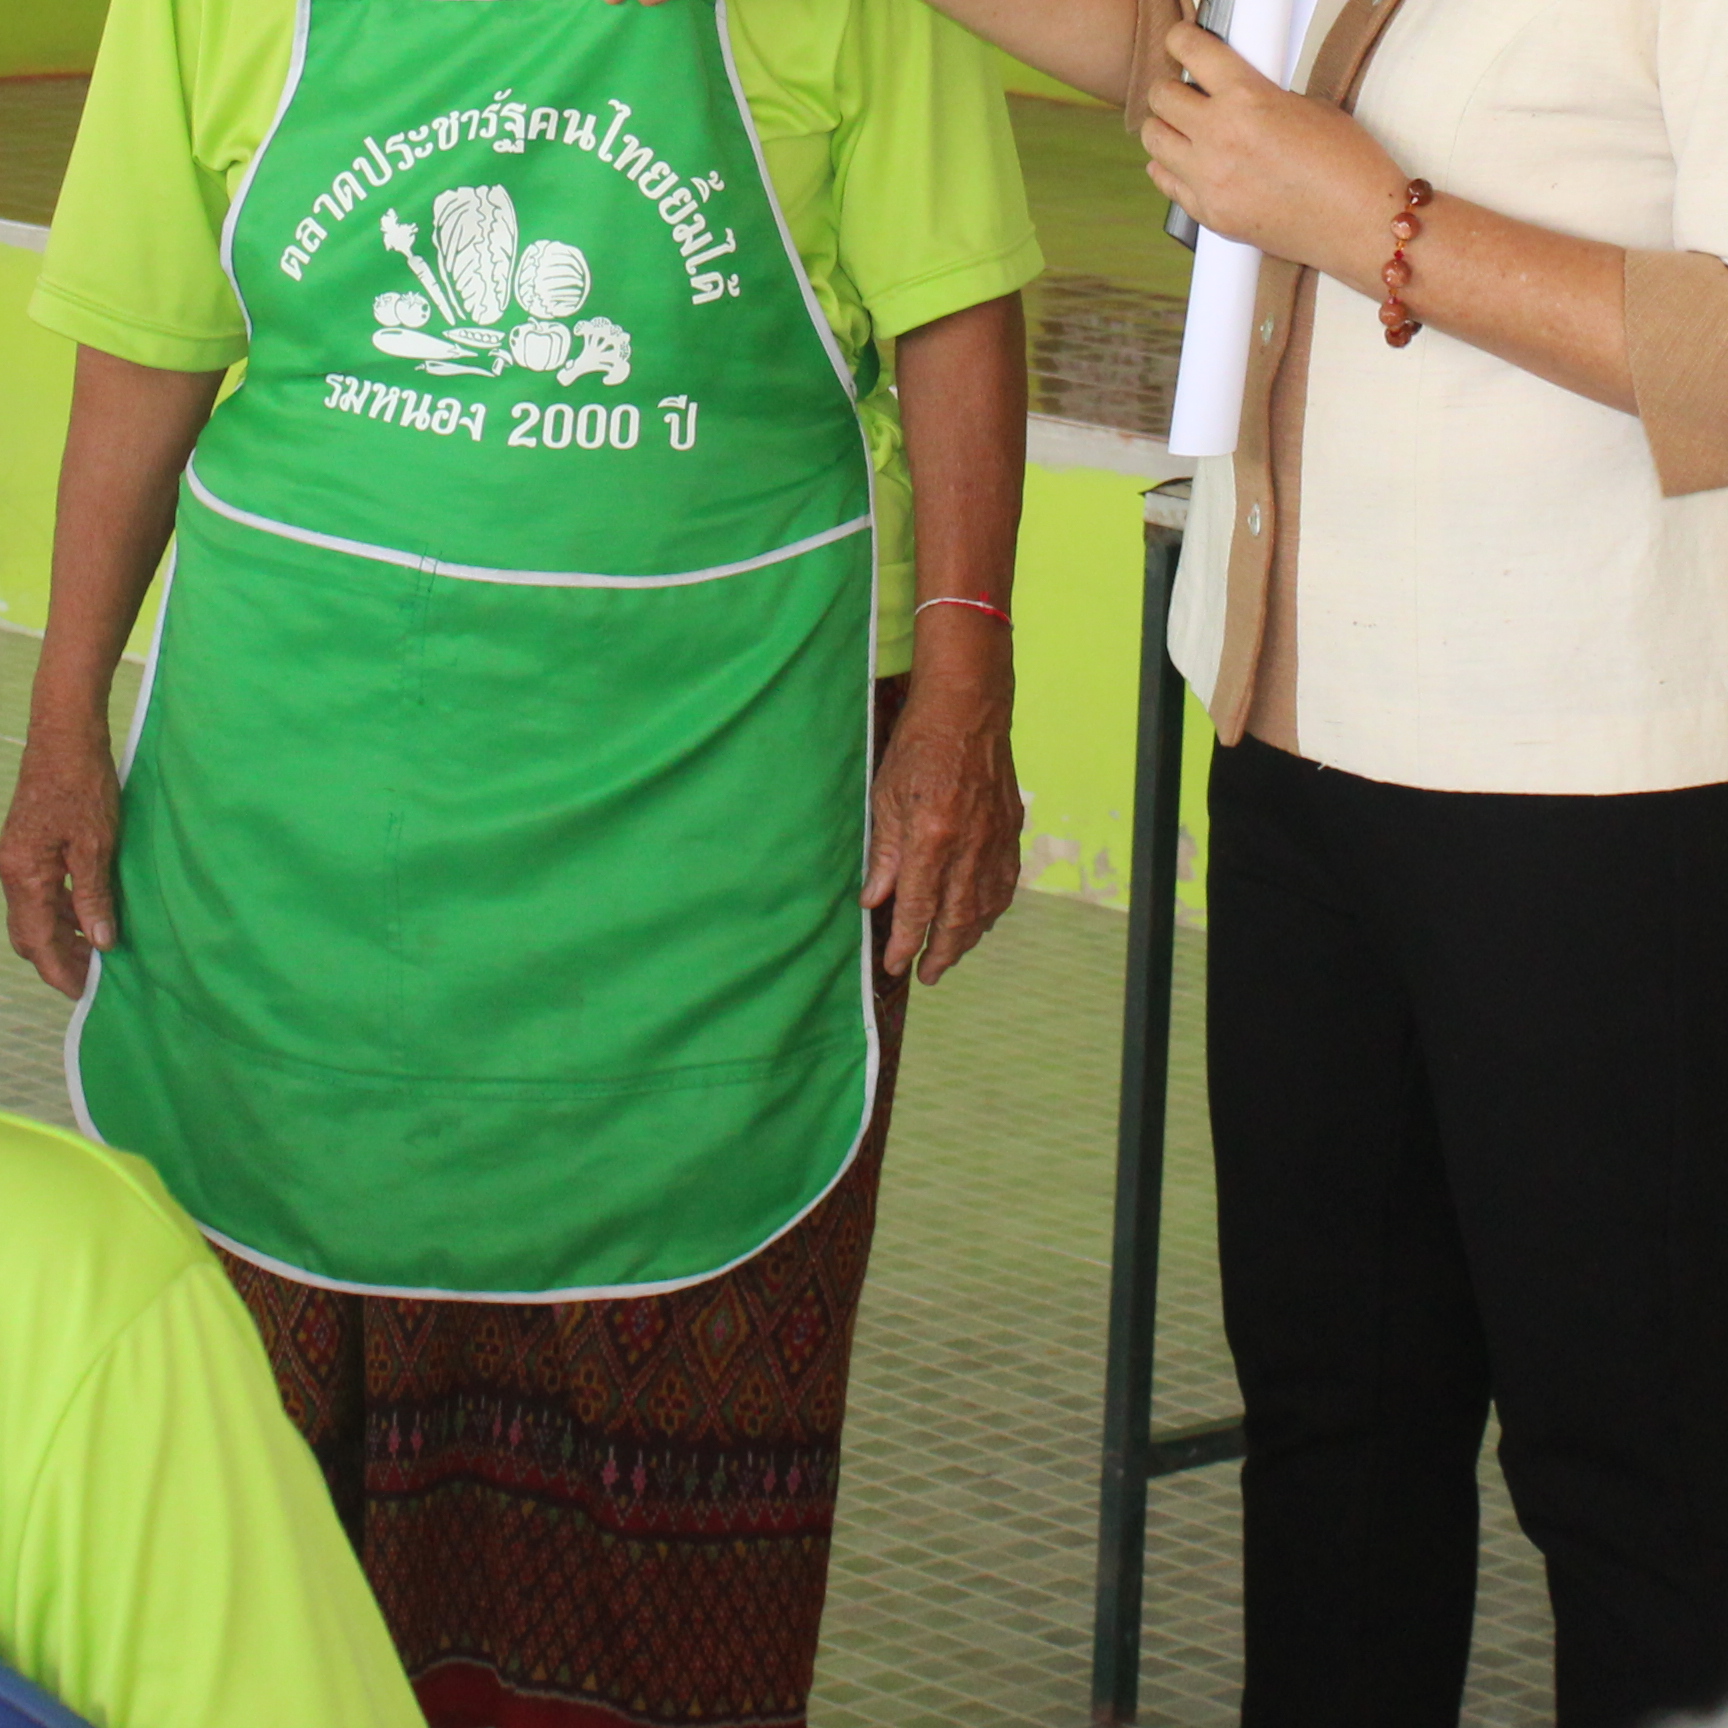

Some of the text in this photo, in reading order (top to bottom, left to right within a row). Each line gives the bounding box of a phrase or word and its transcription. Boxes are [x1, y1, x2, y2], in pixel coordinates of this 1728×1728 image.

[278, 88, 741, 306] ตลาดประชารัฐคนไทยยิ้มได้
[322, 371, 698, 452] รมหนอง 2000 ปี
